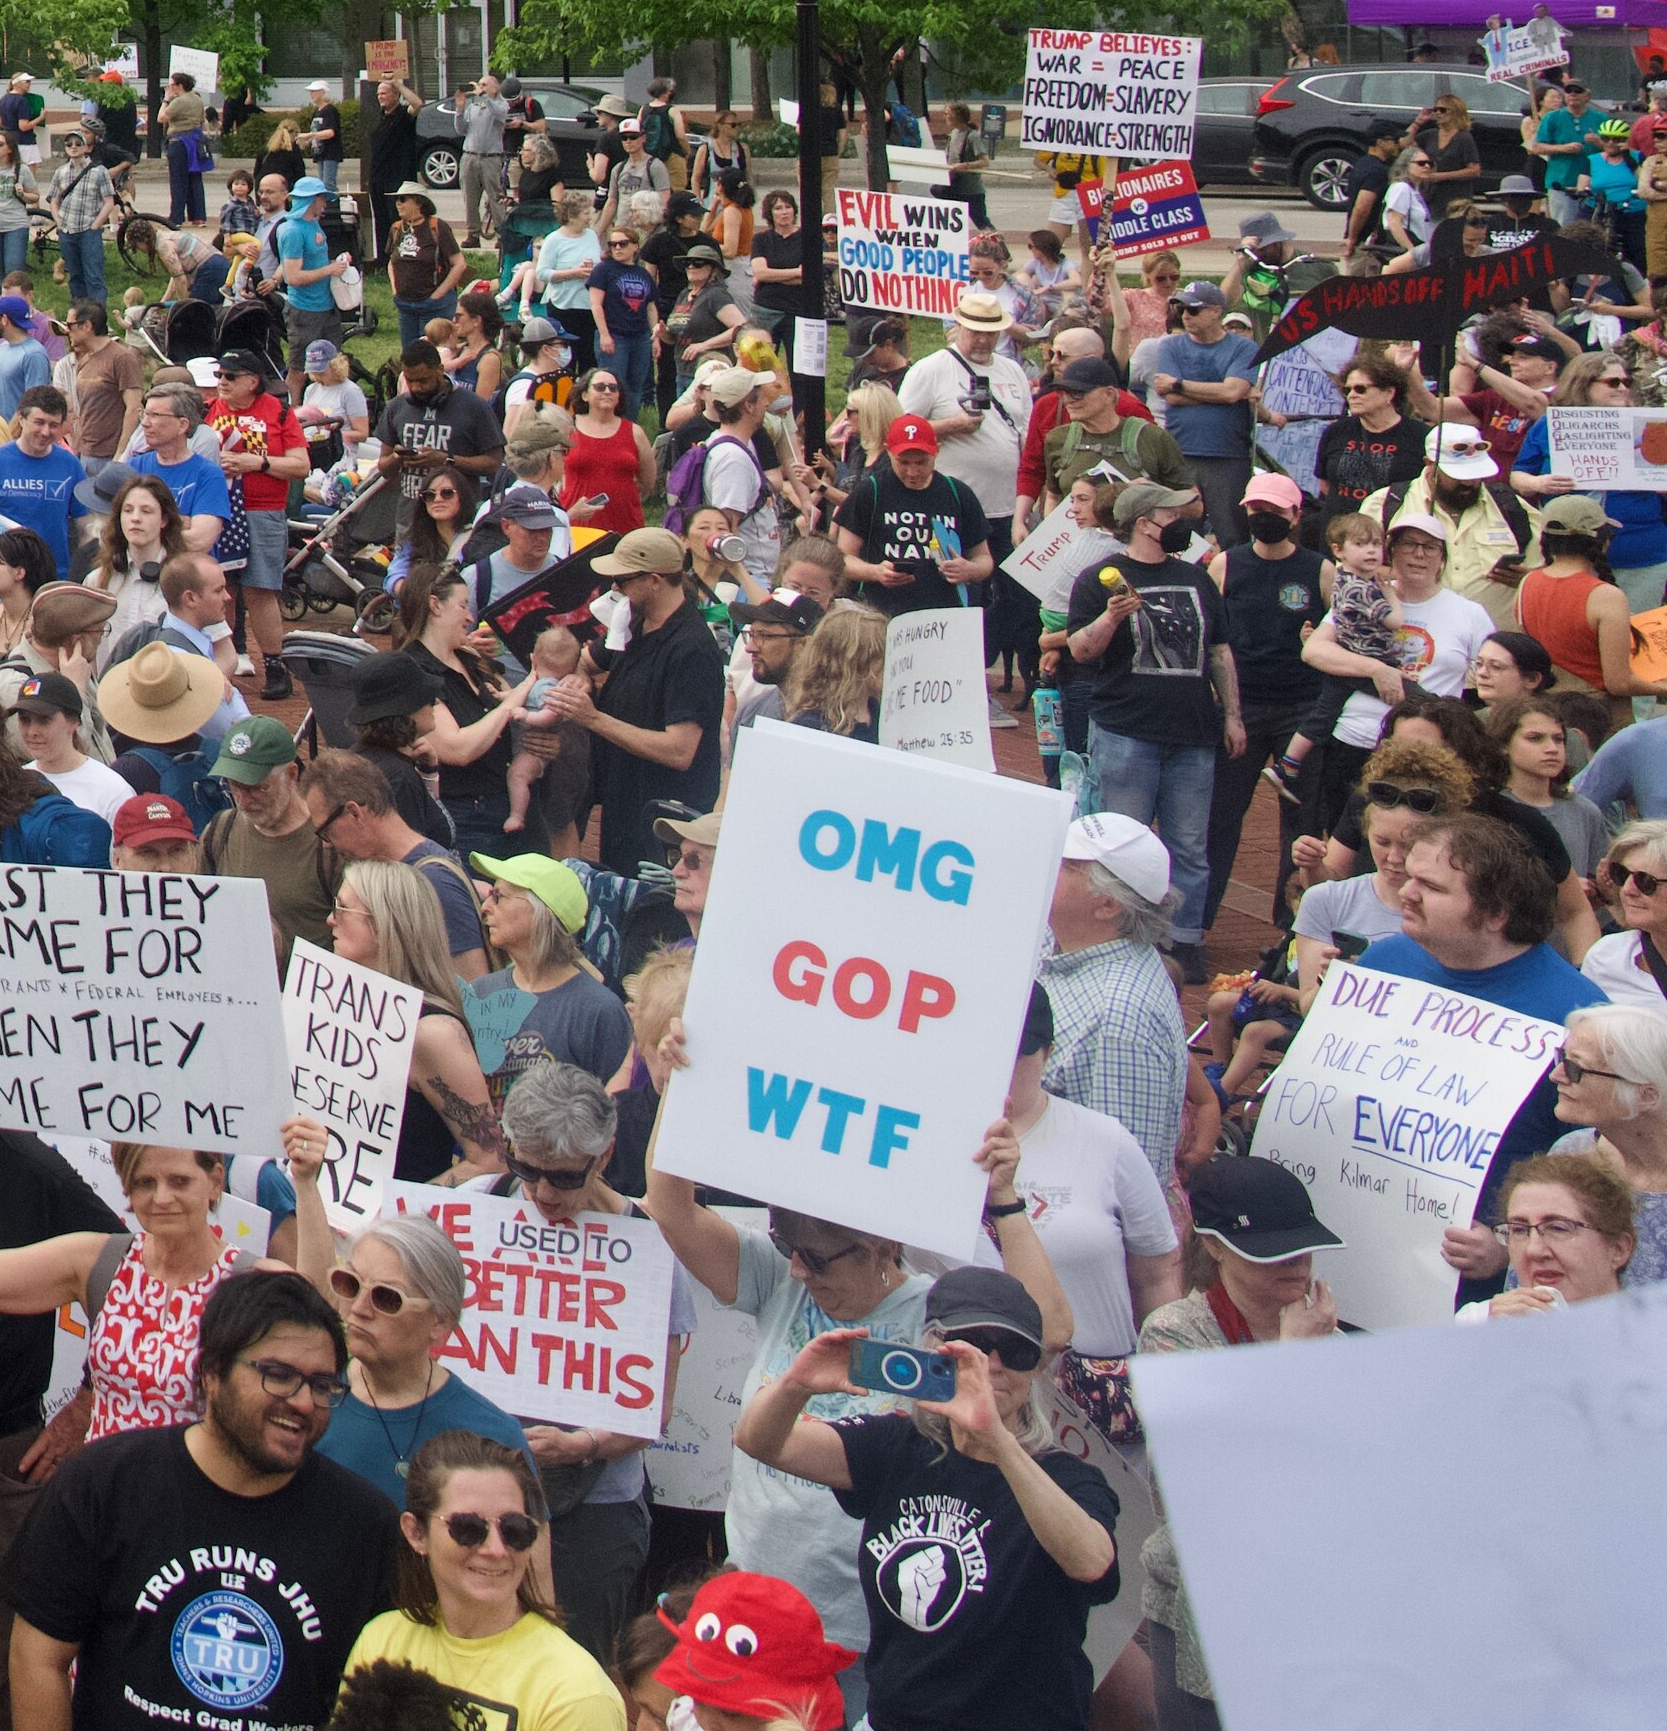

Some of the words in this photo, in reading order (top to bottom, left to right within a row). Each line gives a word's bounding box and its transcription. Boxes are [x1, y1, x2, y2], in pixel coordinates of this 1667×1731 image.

[1029, 29, 1093, 50] TRUMP
[1037, 52, 1081, 74] WAR
[1119, 58, 1184, 80] PEACE
[1489, 69, 1515, 83] REAL
[1519, 53, 1568, 75] CRIMINALS
[838, 189, 899, 231] EVIL
[904, 204, 963, 233] WINS
[1153, 206, 1194, 230] CLASS
[840, 237, 894, 272] GOOD
[902, 248, 970, 282] PEOPLE
[875, 229, 939, 249] WHEN
[1141, 239, 1164, 251] SOLD
[1181, 231, 1199, 242] OUT
[841, 269, 868, 303] DO
[1278, 300, 1319, 344] US
[1323, 283, 1399, 316] HANDS
[1403, 275, 1446, 304] OFF
[1462, 243, 1554, 308] HAITI
[403, 424, 452, 451] FEAR
[1551, 408, 1619, 420] DISGUSTING
[3, 477, 43, 490] ALLIES
[1571, 453, 1619, 467] HANDS
[798, 809, 975, 906] OMG
[83, 870, 219, 924] THEY
[105, 926, 202, 979] FOR
[75, 981, 145, 1002] FEDERAL
[294, 953, 407, 1043] TRANS
[772, 938, 956, 1036] GOP
[72, 1009, 204, 1068] THEY
[1331, 970, 1401, 1017] DUE
[1412, 992, 1558, 1060] PROCESS
[306, 1012, 381, 1080] KIDS
[1312, 1033, 1381, 1074] RULE
[1380, 1053, 1420, 1082] OF
[1417, 1065, 1488, 1107] LAW
[78, 1083, 162, 1133] FOR
[185, 1100, 244, 1138] ME
[747, 1065, 920, 1170] WTF
[1274, 1078, 1337, 1135] FOR
[1354, 1094, 1500, 1170] EVERYONE
[1340, 1158, 1390, 1194] Kilmar
[1406, 1178, 1460, 1224] Home!
[500, 1221, 580, 1255] USED
[590, 1237, 632, 1263] TO
[460, 1258, 627, 1331] BETTER
[899, 1494, 981, 1524] CATONSVILLE
[866, 1514, 925, 1562] BLACK
[135, 1558, 185, 1612] TRU
[189, 1545, 277, 1581] RUNS
[278, 1581, 322, 1641] JHU
[176, 1601, 204, 1638] TEACHERS
[212, 1595, 267, 1624] RESEARCHERS
[265, 1624, 279, 1656] UNITED
[175, 1651, 192, 1683] JOHNS
[191, 1681, 231, 1704] HOPKINS
[233, 1668, 277, 1704] UNIVERSITY
[194, 1639, 259, 1673] TRU
[124, 1684, 190, 1724] Respect
